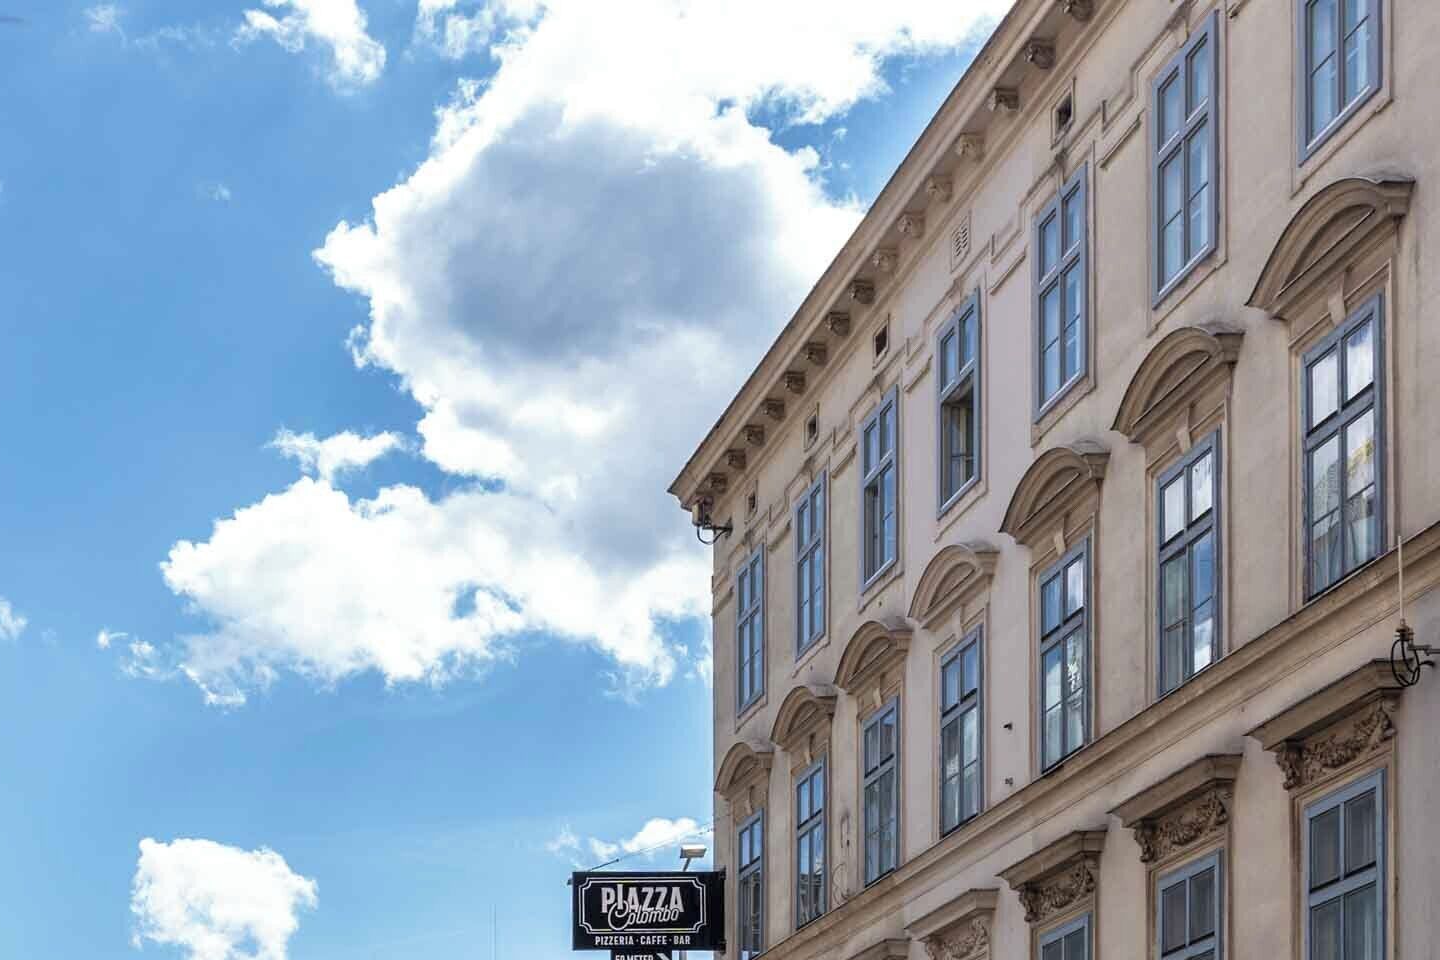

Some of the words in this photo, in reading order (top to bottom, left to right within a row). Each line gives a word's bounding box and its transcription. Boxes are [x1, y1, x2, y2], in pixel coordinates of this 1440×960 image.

[601, 884, 685, 913] PIAZZA
[607, 901, 680, 931] Colombo
[595, 936, 635, 945] PIZZERIA
[640, 936, 667, 945] CAFFE
[673, 936, 691, 944] BAR
